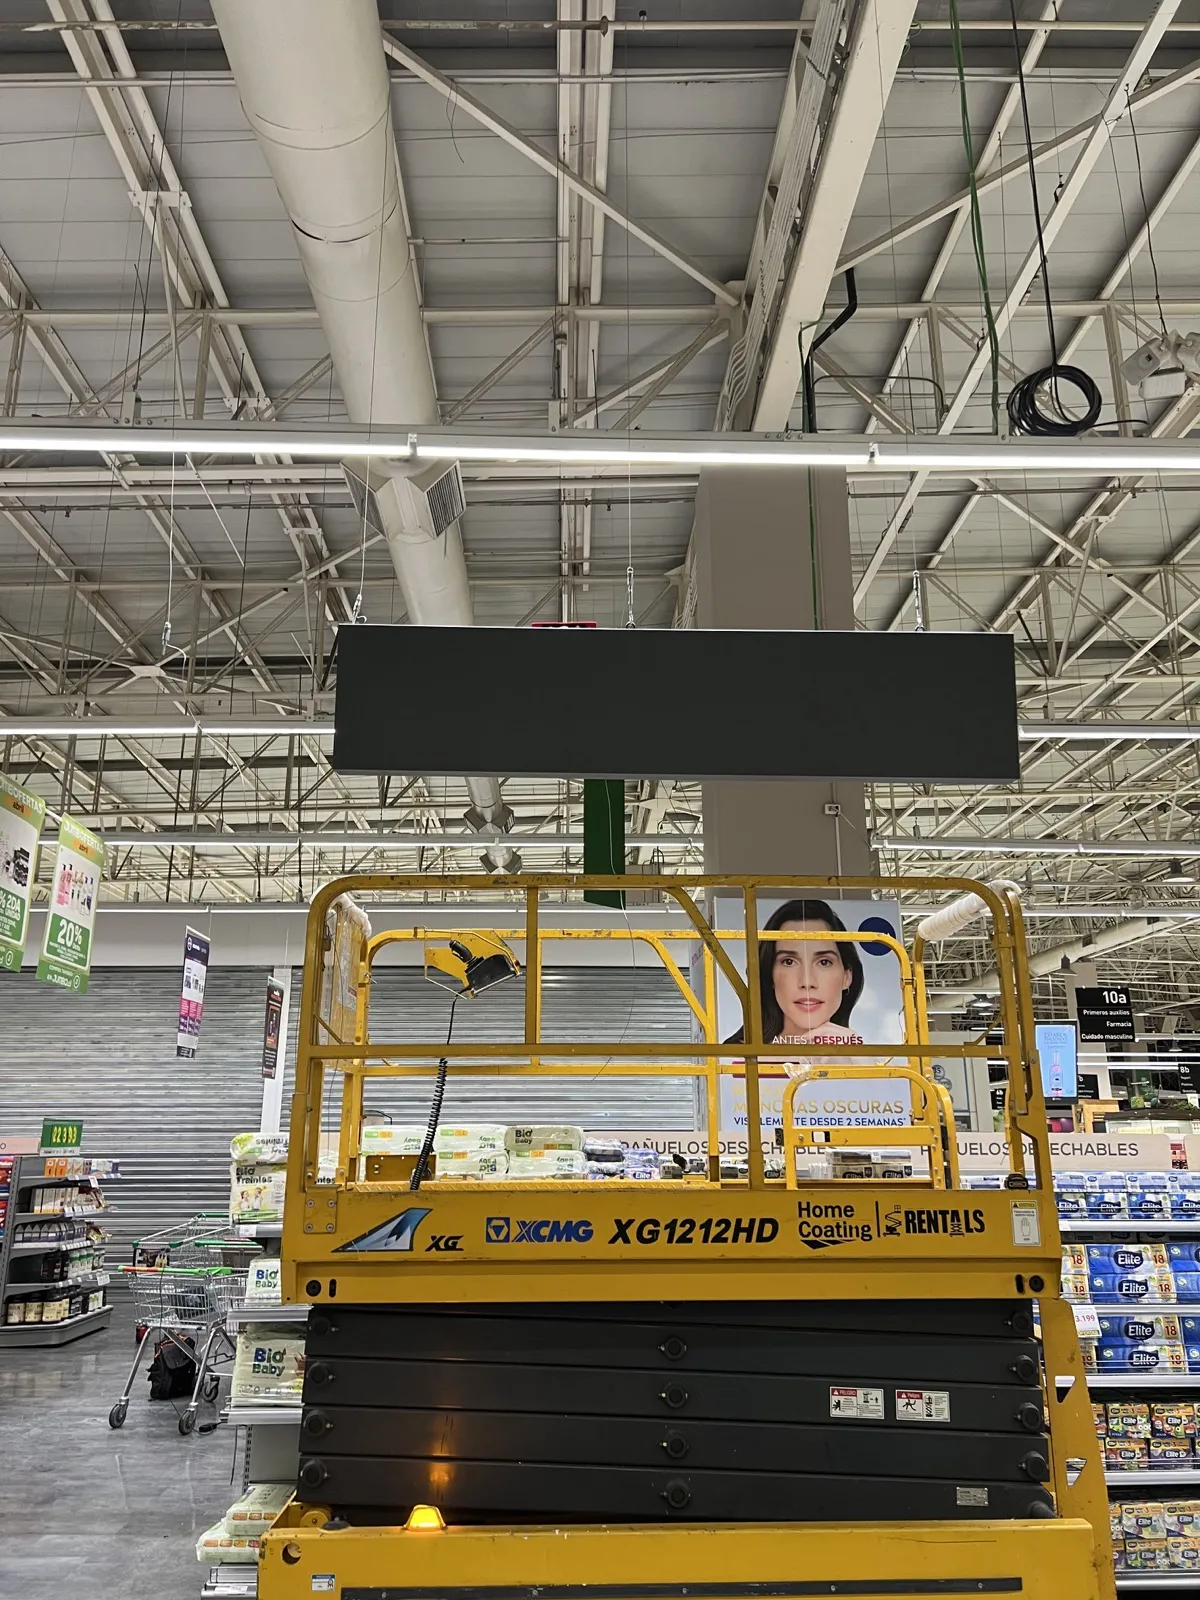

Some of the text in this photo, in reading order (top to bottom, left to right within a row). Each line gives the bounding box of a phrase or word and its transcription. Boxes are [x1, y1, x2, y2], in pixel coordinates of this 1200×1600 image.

[57, 919, 82, 947] 20%
[1102, 991, 1127, 1004] 10a
[772, 1034, 864, 1045] ANTES DESPUÉS
[733, 1100, 904, 1114] MNCAS OSCURAS
[733, 1116, 806, 1126] VISLEMTE
[809, 1117, 844, 1126] DESDE
[846, 1117, 853, 1126] 2
[515, 1129, 533, 1137] Bio
[1018, 1142, 1139, 1156] DEECHABLES
[236, 1167, 256, 1176] Bio
[635, 1171, 651, 1179] Elite
[798, 1201, 854, 1218] Home
[904, 1208, 985, 1237] RENTALS
[511, 1220, 593, 1243] XCMG
[608, 1217, 779, 1244] XG1212HD
[798, 1221, 873, 1242] Coating
[425, 1235, 464, 1252] XG
[1071, 1255, 1083, 1265] 18
[1118, 1254, 1142, 1265] Elite
[1153, 1254, 1165, 1265] 18
[256, 1269, 278, 1280] Bio
[255, 1280, 278, 1288] Baby
[1122, 1283, 1146, 1293] Elite
[1159, 1284, 1171, 1293] 18
[1073, 1286, 1085, 1296] 18
[1128, 1325, 1152, 1336] Elite
[1165, 1326, 1177, 1336] 18
[254, 1348, 286, 1364] Bio
[1133, 1355, 1157, 1365] Elite
[1170, 1355, 1181, 1365] 18
[252, 1363, 285, 1377] Baby
